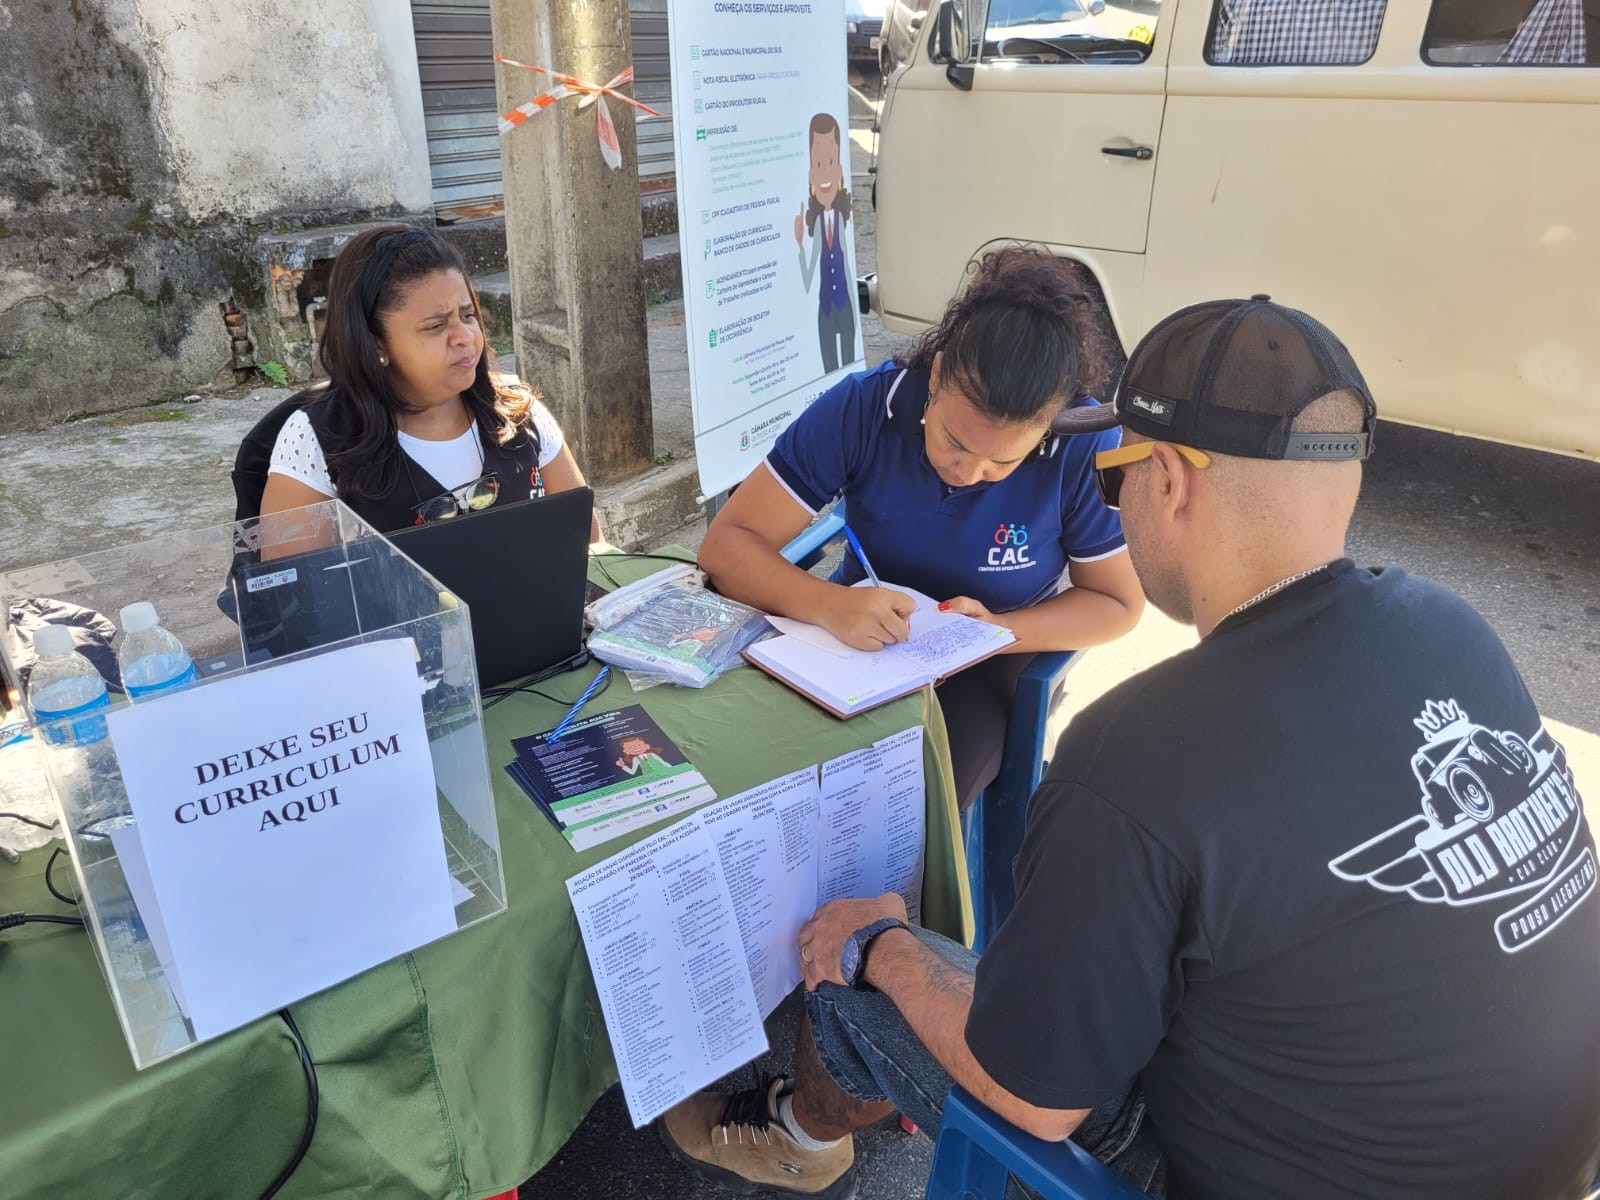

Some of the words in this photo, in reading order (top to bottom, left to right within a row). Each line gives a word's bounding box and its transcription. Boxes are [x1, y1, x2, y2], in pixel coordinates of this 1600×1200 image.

[714, 3, 744, 15] CONHEÇA
[744, 3, 753, 13] OS
[753, 3, 780, 15] SERVIÇOS
[780, 3, 784, 13] E
[701, 48, 719, 56] CARTÃO
[719, 47, 741, 55] NACIONAL
[745, 46, 767, 54] MUNICIPAL
[703, 75, 714, 84] NOTA
[715, 74, 729, 83] FISCAL
[729, 72, 755, 82] ELETRÔNICA
[704, 100, 721, 110] CARTÃO
[722, 100, 728, 108] DO
[729, 98, 751, 107] PRODUTOR
[752, 96, 766, 105] RURAL
[713, 230, 740, 245] ELABORAÇÃO
[741, 229, 746, 238] DE
[747, 222, 772, 236] CURRÍCULOS
[713, 245, 729, 256] BANCO
[729, 243, 734, 252] DE
[735, 239, 750, 250] DADOS
[751, 238, 755, 246] DE
[756, 231, 780, 245] CURRÍCULOS
[716, 268, 747, 284] AGENDAMENTO
[716, 284, 731, 295] Carteira
[719, 317, 746, 334] ELABORAÇÃO
[747, 315, 752, 324] DE
[753, 309, 769, 322] BOLETIM
[719, 335, 724, 344] DE
[725, 325, 752, 342] OCORRÊNCIA
[751, 419, 769, 434] CÂMARA
[987, 545, 1030, 566] CAC
[193, 734, 302, 786] DEIXE
[309, 711, 369, 748] SEU
[174, 733, 402, 824] CURRICULUM
[259, 786, 342, 832] AQUI
[702, 805, 723, 819] RELAÇÃO
[729, 797, 743, 808] VAGAS
[751, 799, 773, 814] TRABALHO
[1437, 833, 1498, 894] OLD
[1484, 771, 1576, 868] BROTHER'S
[573, 871, 595, 887] RELAÇÃO
[594, 867, 602, 876] DE
[601, 859, 618, 872] VAGAS
[617, 845, 645, 864] DISPONÍVEIS
[645, 838, 657, 850] PELO
[657, 833, 667, 843] CAC
[669, 823, 687, 837] CENTRO
[571, 883, 587, 896] APOIO
[587, 879, 596, 888] AO
[595, 868, 617, 884] CIDADÃO
[616, 863, 625, 873] EM
[624, 852, 647, 868] PARCERIA
[646, 846, 658, 857] COM
[627, 857, 653, 875] TRABALHO
[1510, 903, 1550, 940] POUSO
